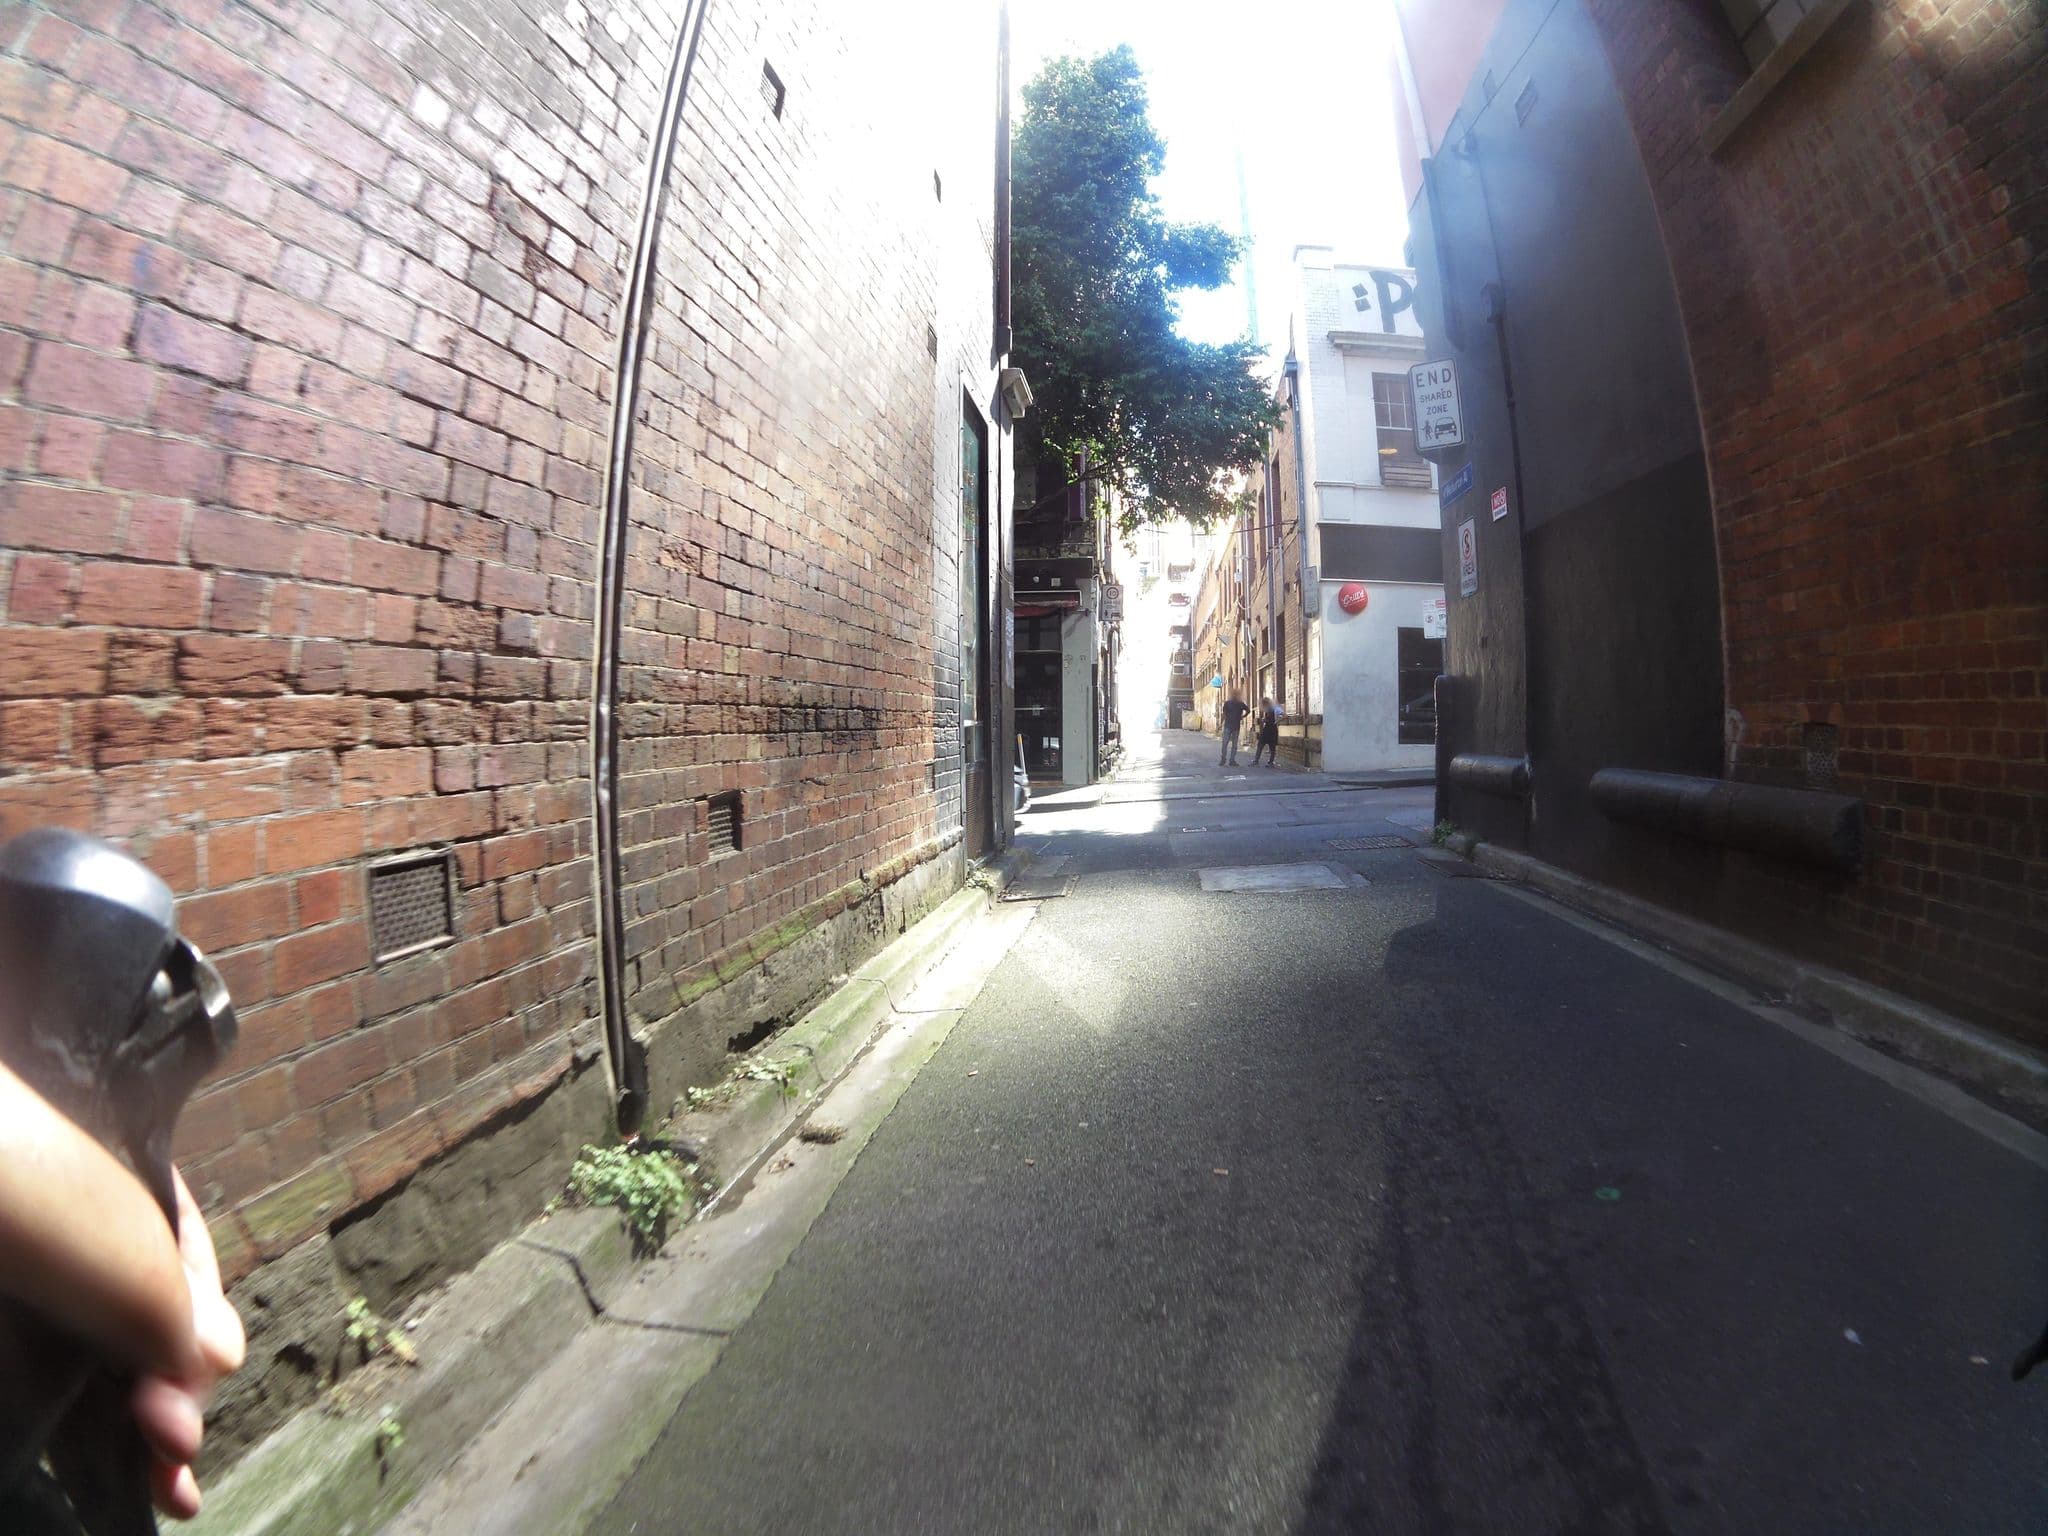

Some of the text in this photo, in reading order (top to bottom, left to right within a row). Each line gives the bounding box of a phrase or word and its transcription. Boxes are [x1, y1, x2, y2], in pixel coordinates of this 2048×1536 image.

[1416, 368, 1452, 388] END
[1420, 390, 1453, 403] SHARED
[1426, 403, 1449, 416] ZONE
